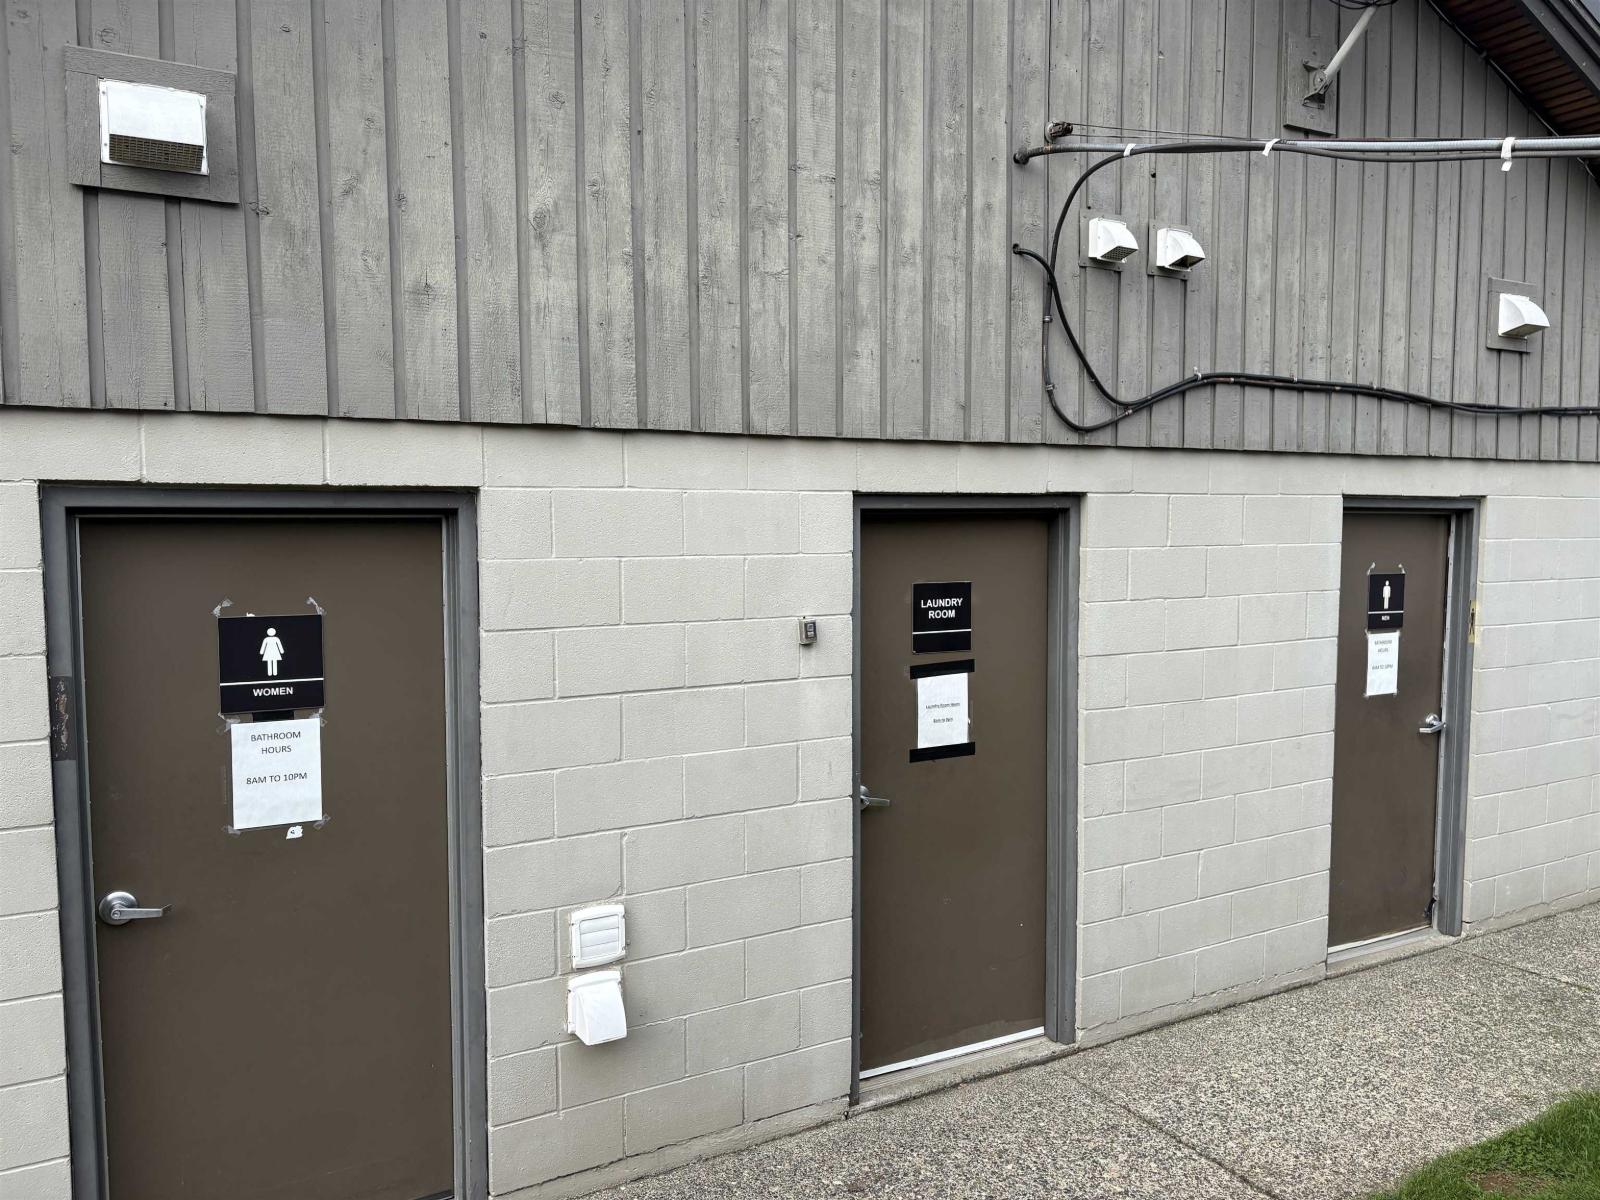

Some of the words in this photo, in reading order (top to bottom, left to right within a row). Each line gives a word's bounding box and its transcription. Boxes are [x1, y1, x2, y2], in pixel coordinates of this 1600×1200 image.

[920, 597, 963, 608] LAUNDRY
[928, 609, 956, 619] ROOM
[252, 686, 294, 697] WOMEN
[250, 731, 301, 742] BATHROOM
[261, 745, 292, 755] HOURS
[246, 776, 267, 785] 8AM
[269, 774, 281, 783] TO
[283, 772, 308, 782] 10PM
